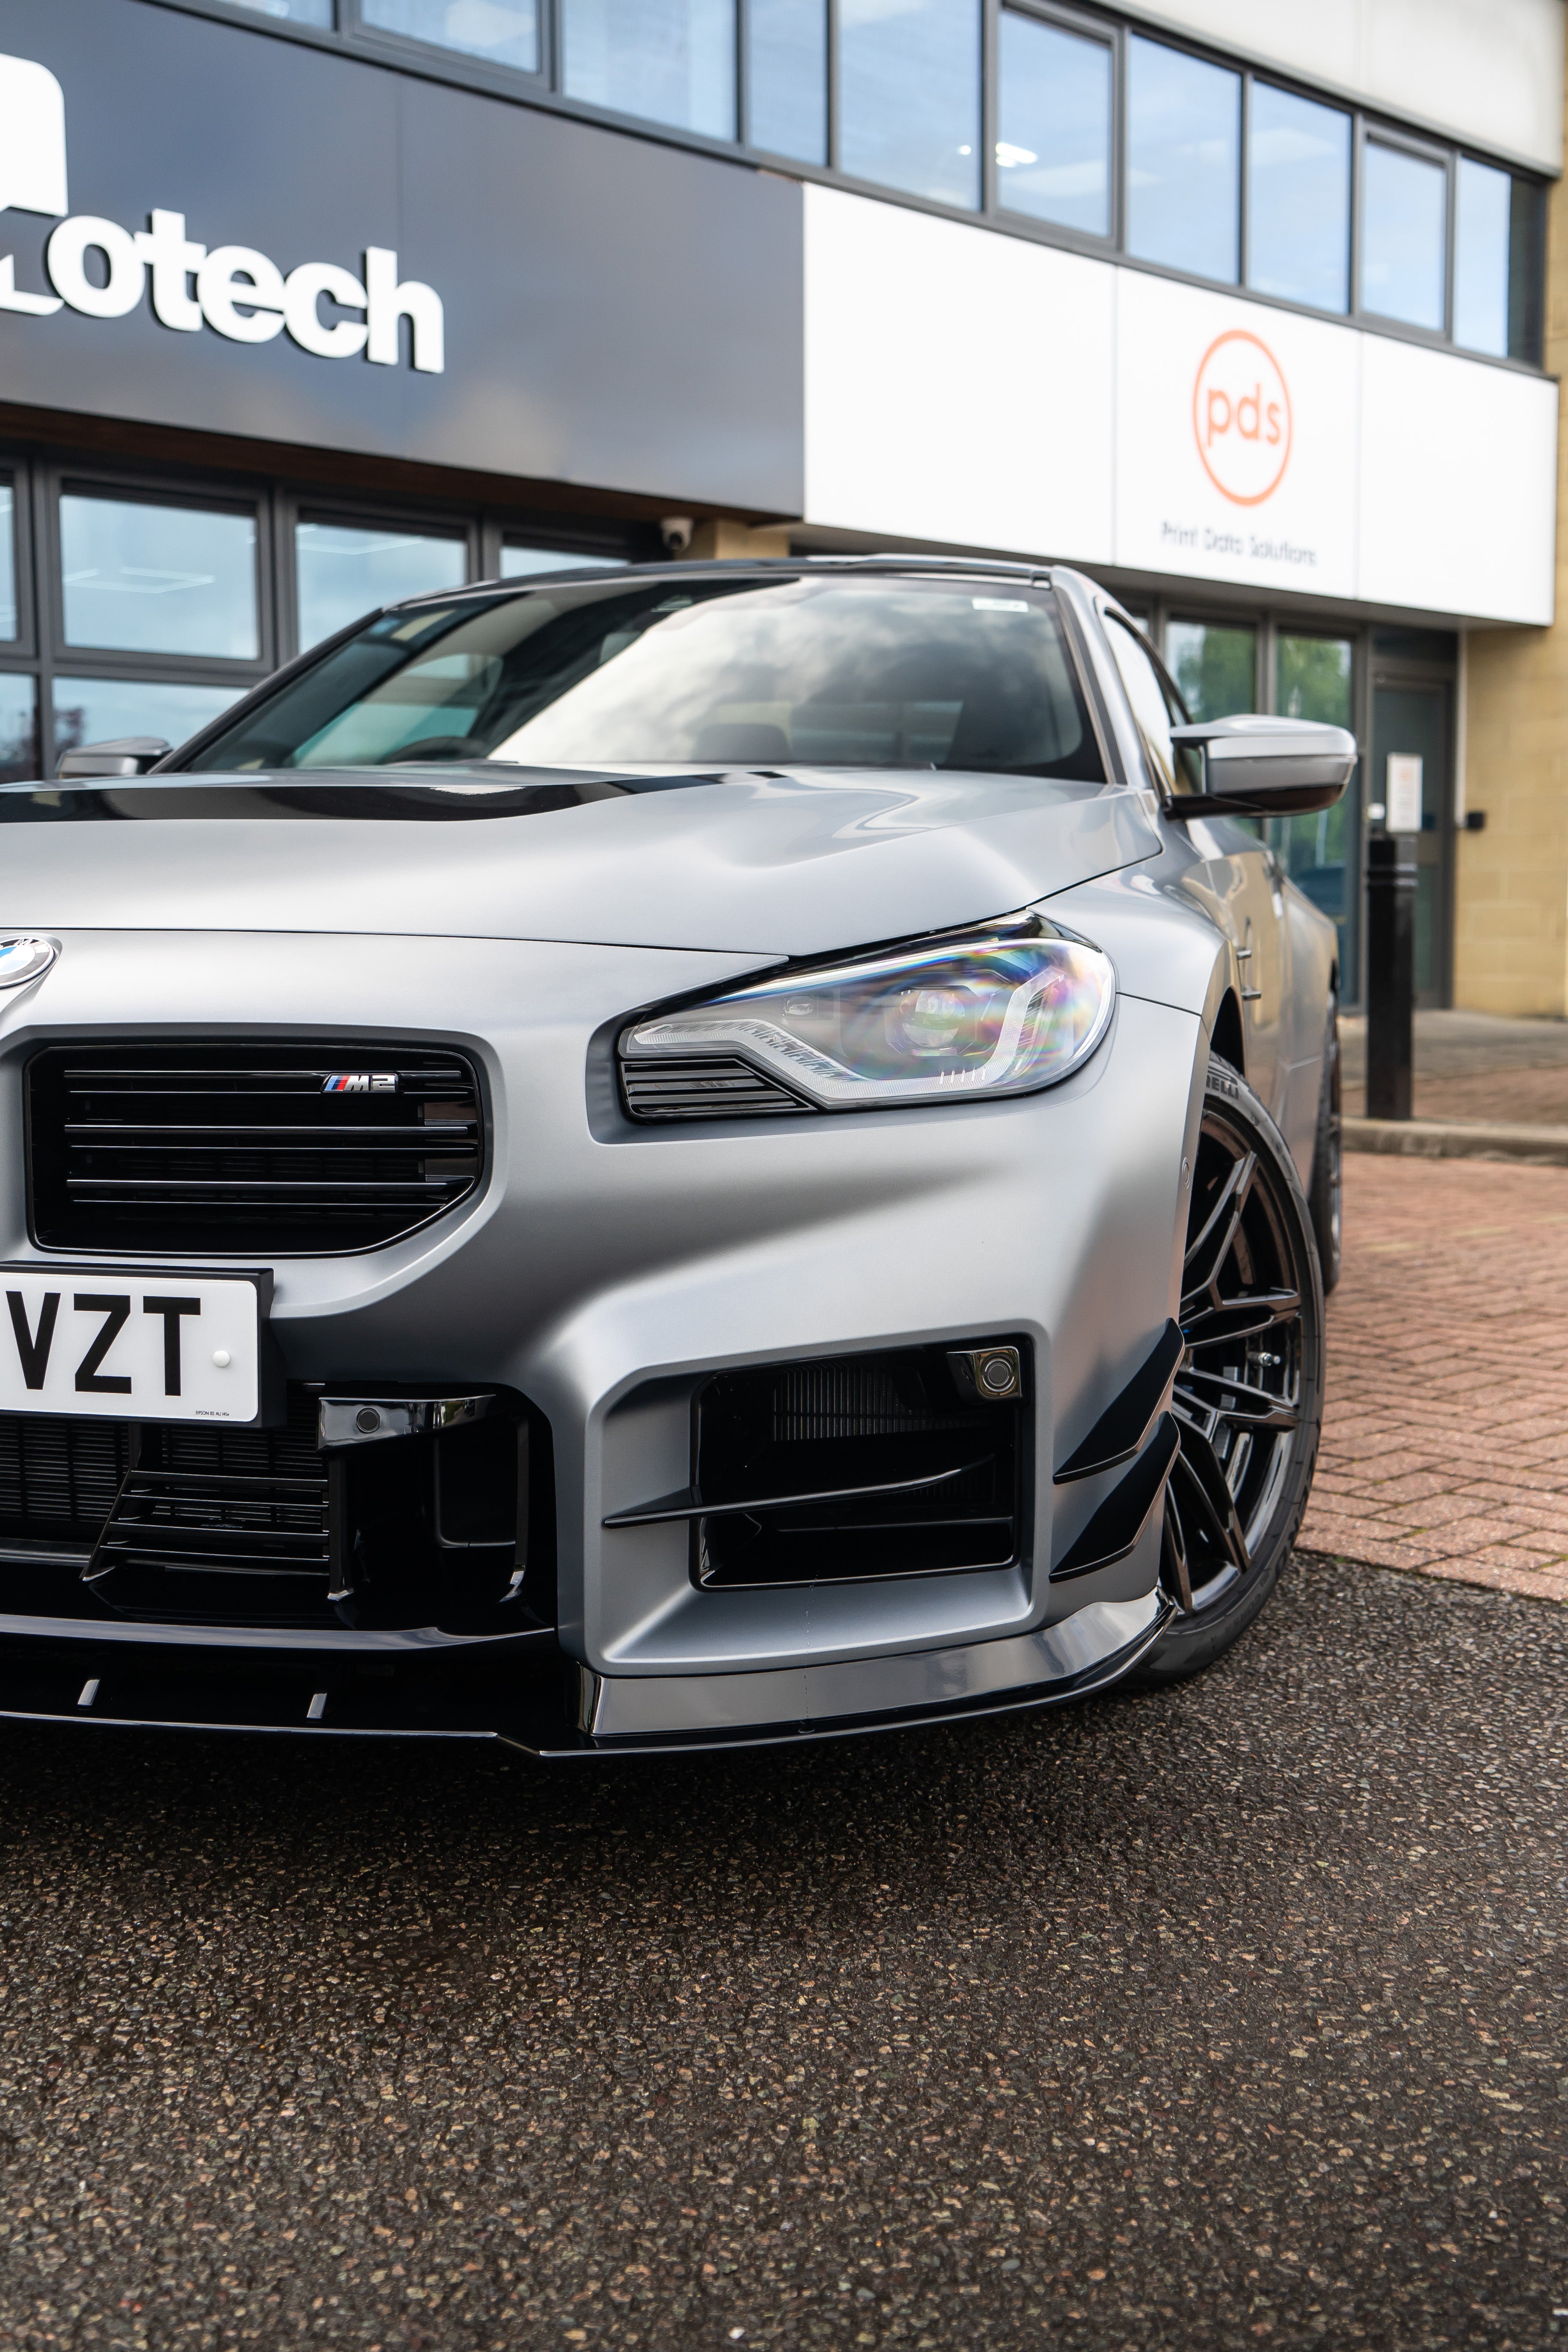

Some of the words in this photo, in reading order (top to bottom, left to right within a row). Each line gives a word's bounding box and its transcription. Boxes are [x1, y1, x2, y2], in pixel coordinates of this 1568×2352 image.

[1207, 382, 1281, 447] pds
[1162, 521, 1198, 547] Print
[1204, 527, 1244, 556] Data
[1250, 535, 1317, 566] Solutions
[344, 1075, 395, 1091] M2
[6, 1291, 201, 1397] VZT
